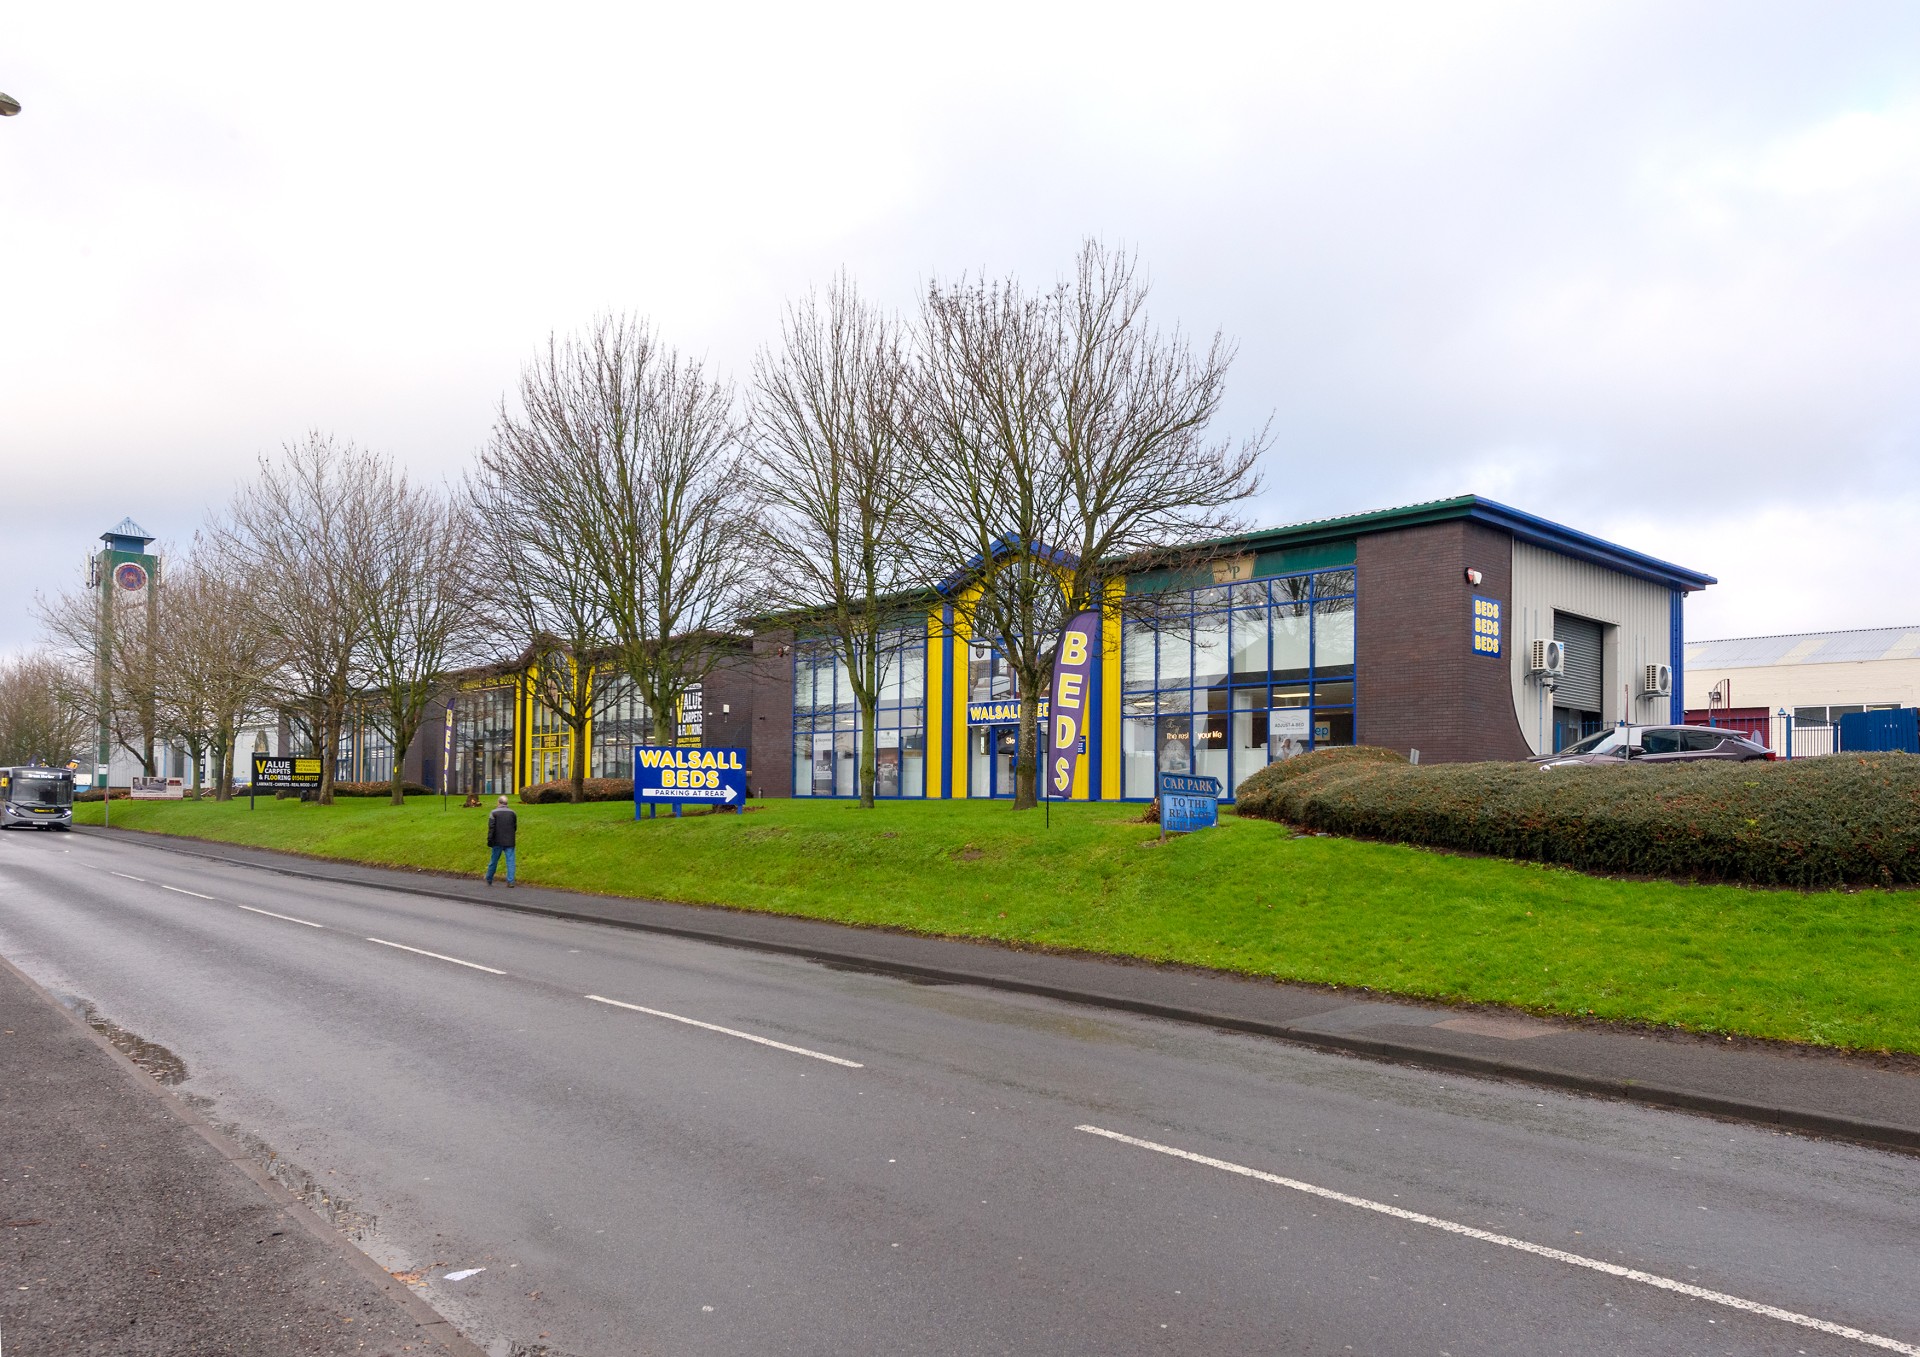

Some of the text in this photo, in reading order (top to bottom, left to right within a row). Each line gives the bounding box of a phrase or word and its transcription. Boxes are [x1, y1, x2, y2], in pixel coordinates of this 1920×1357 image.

[1475, 600, 1498, 618] BEDS
[1475, 618, 1498, 636] BEDS
[1475, 635, 1498, 654] BEDS
[676, 692, 702, 723] VALUE
[1054, 631, 1087, 791] BEDS
[682, 711, 702, 723] CARPETS
[682, 724, 702, 736] FLOORING
[1212, 730, 1222, 738] life
[256, 760, 290, 774] VALUE
[640, 750, 742, 769] WALSALL
[662, 770, 719, 788] BEDS
[1164, 777, 1213, 792] CAR PARK
[1172, 798, 1208, 809] TO THE
[1169, 809, 1195, 818] REAR
